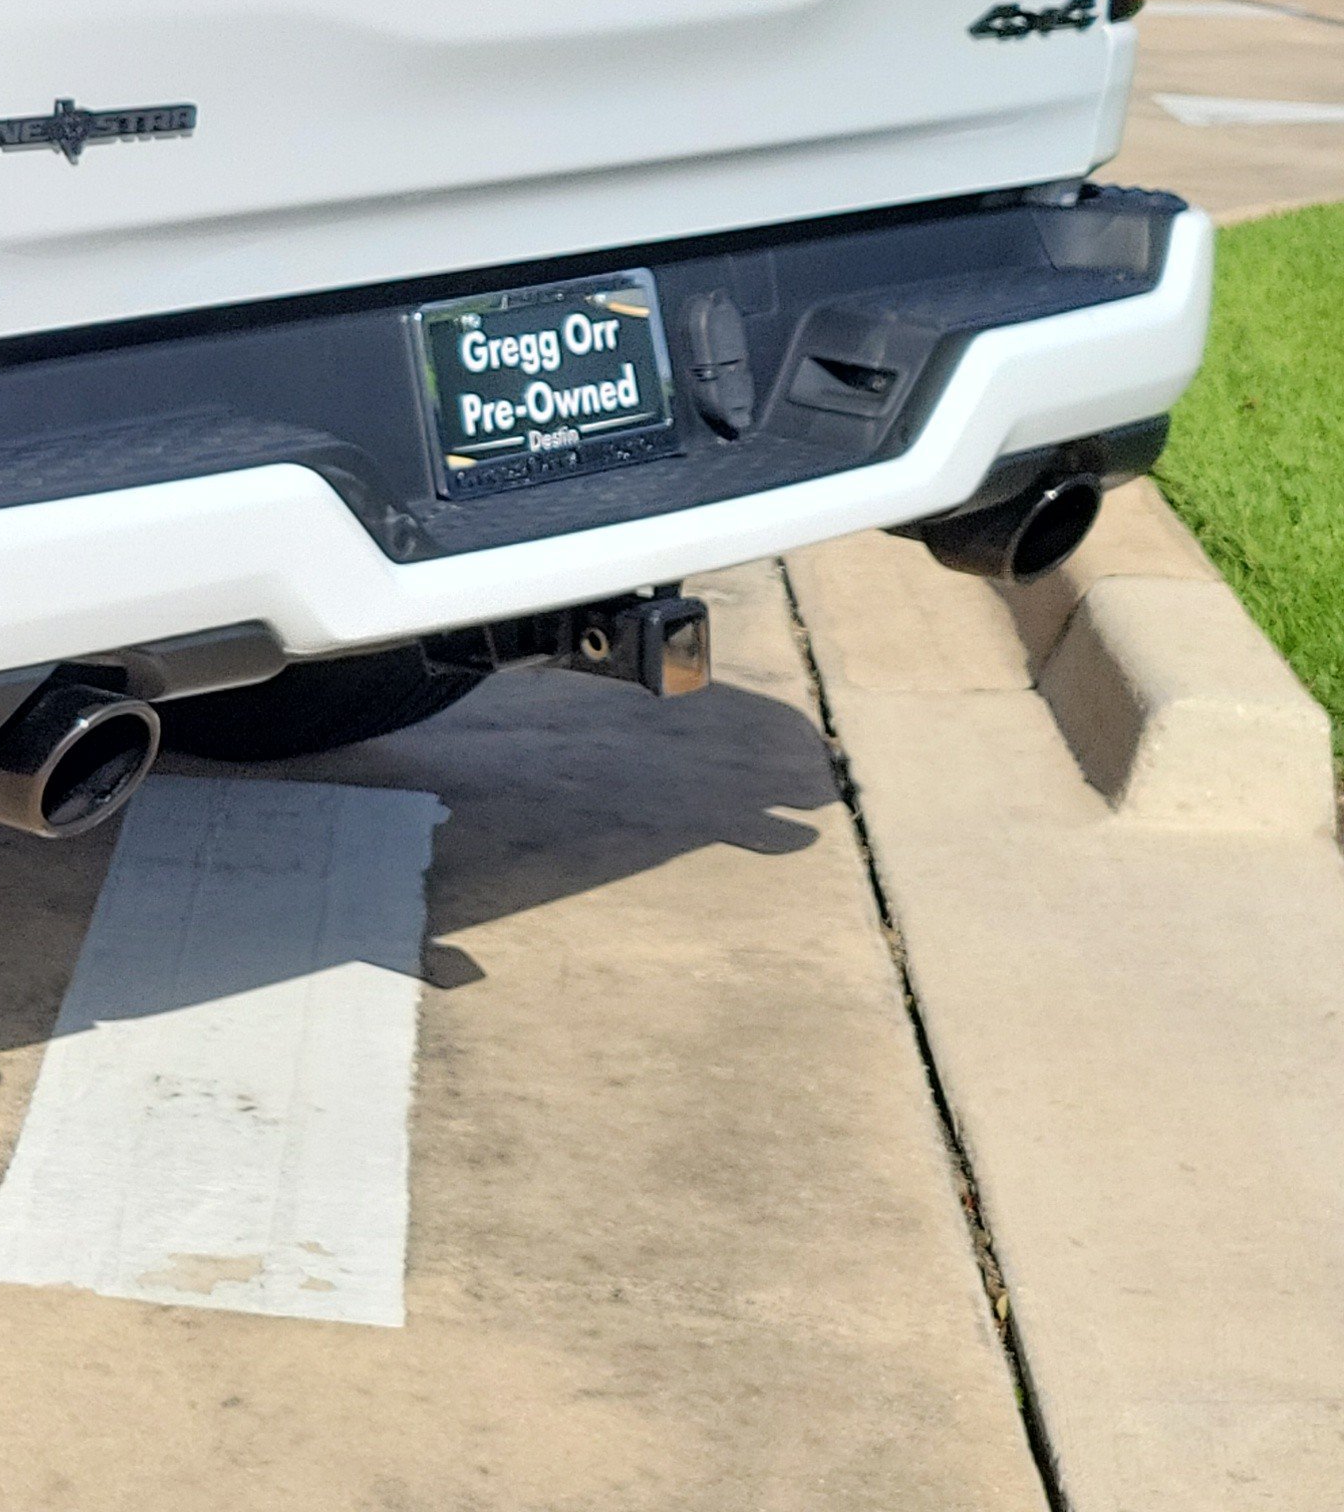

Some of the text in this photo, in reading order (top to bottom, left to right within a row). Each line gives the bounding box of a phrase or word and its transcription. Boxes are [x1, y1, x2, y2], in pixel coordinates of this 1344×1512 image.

[461, 313, 620, 375] Gregg Orr
[461, 362, 640, 437] Pre-Owned
